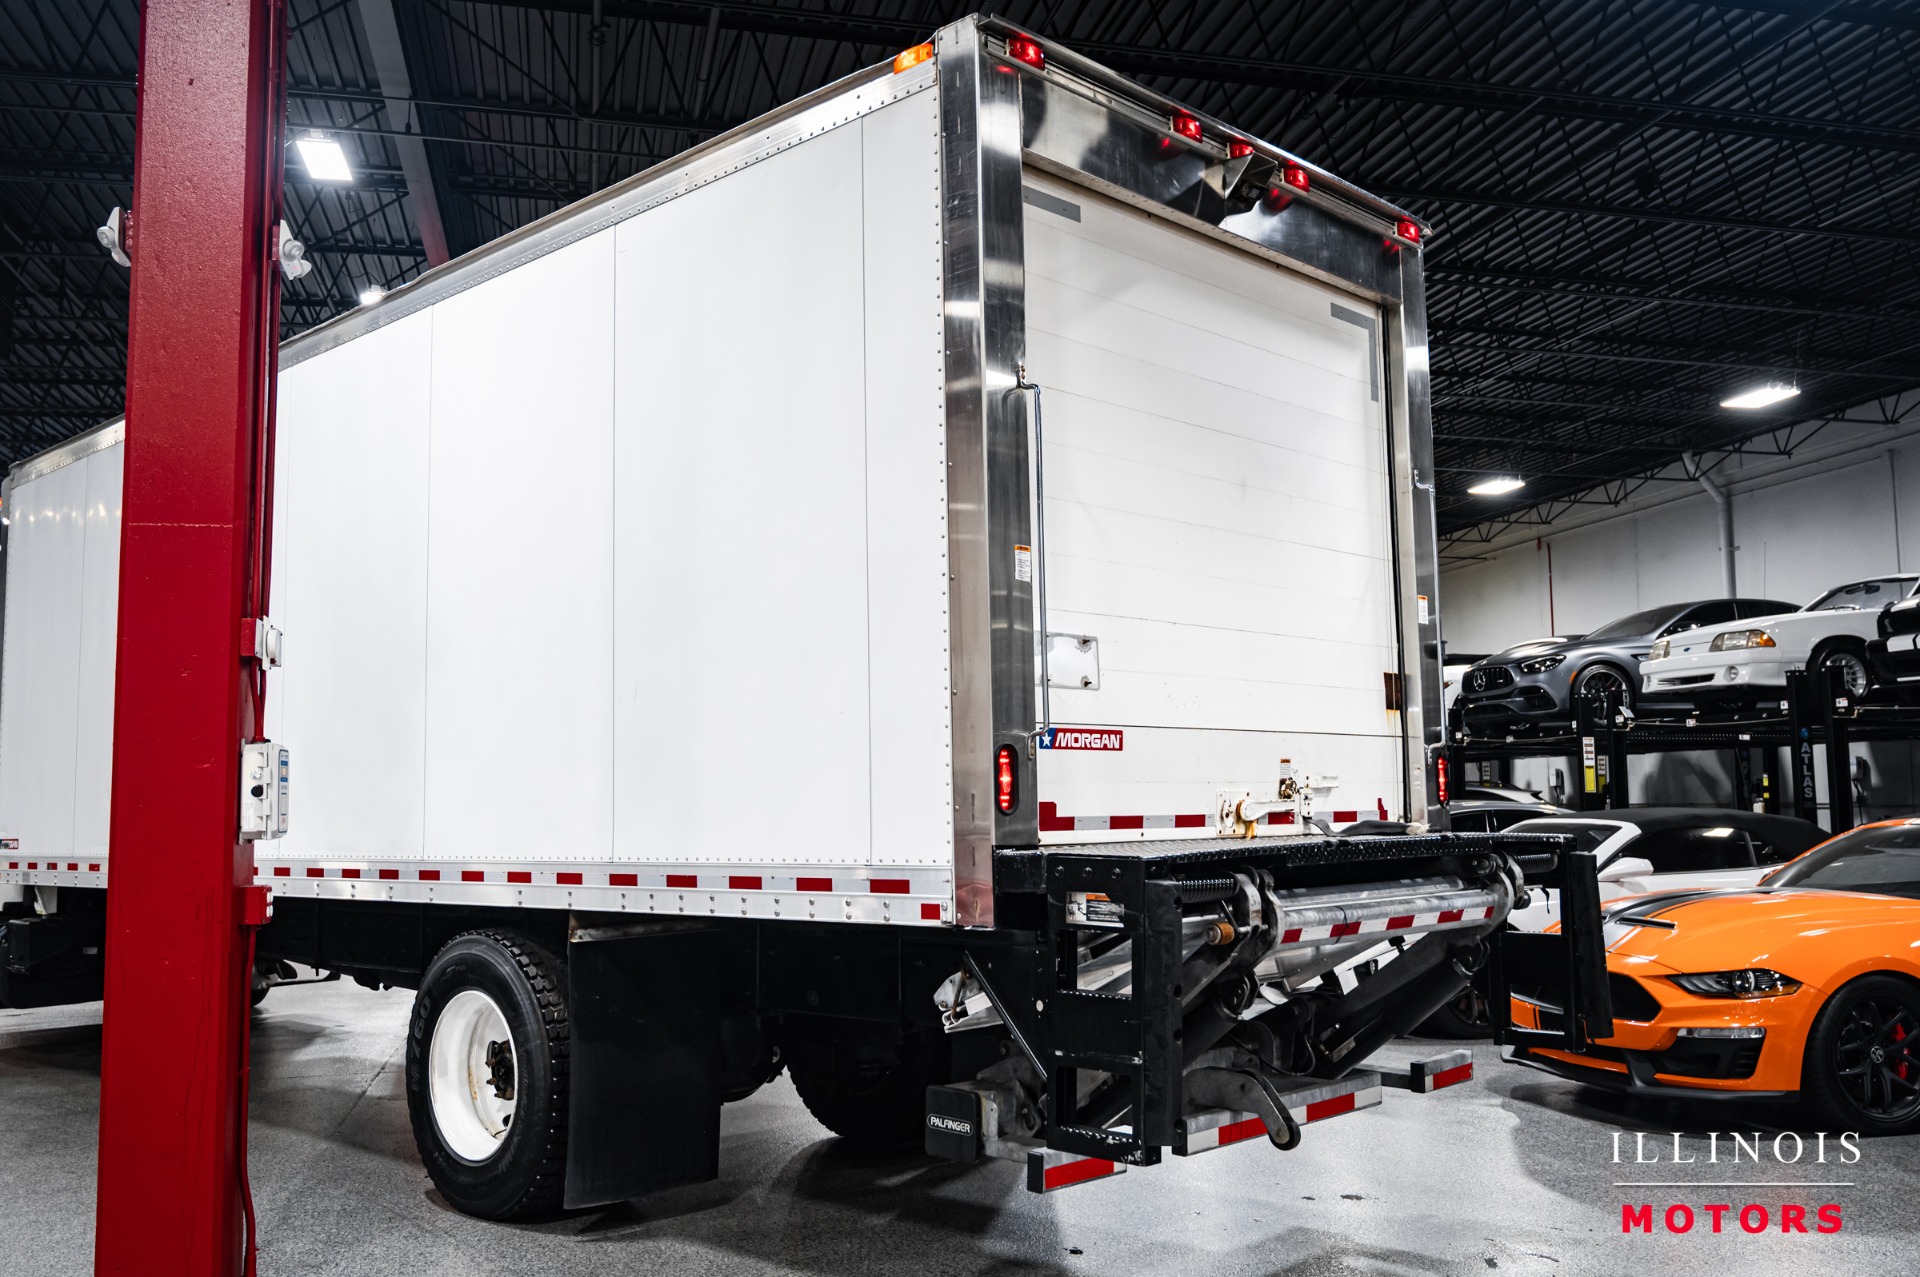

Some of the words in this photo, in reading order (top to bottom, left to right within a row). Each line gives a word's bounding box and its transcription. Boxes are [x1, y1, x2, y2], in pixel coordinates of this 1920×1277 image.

[1055, 732, 1120, 749] MORGAN
[1800, 742, 1815, 799] ATLAS
[930, 1116, 971, 1133] PALFINGER
